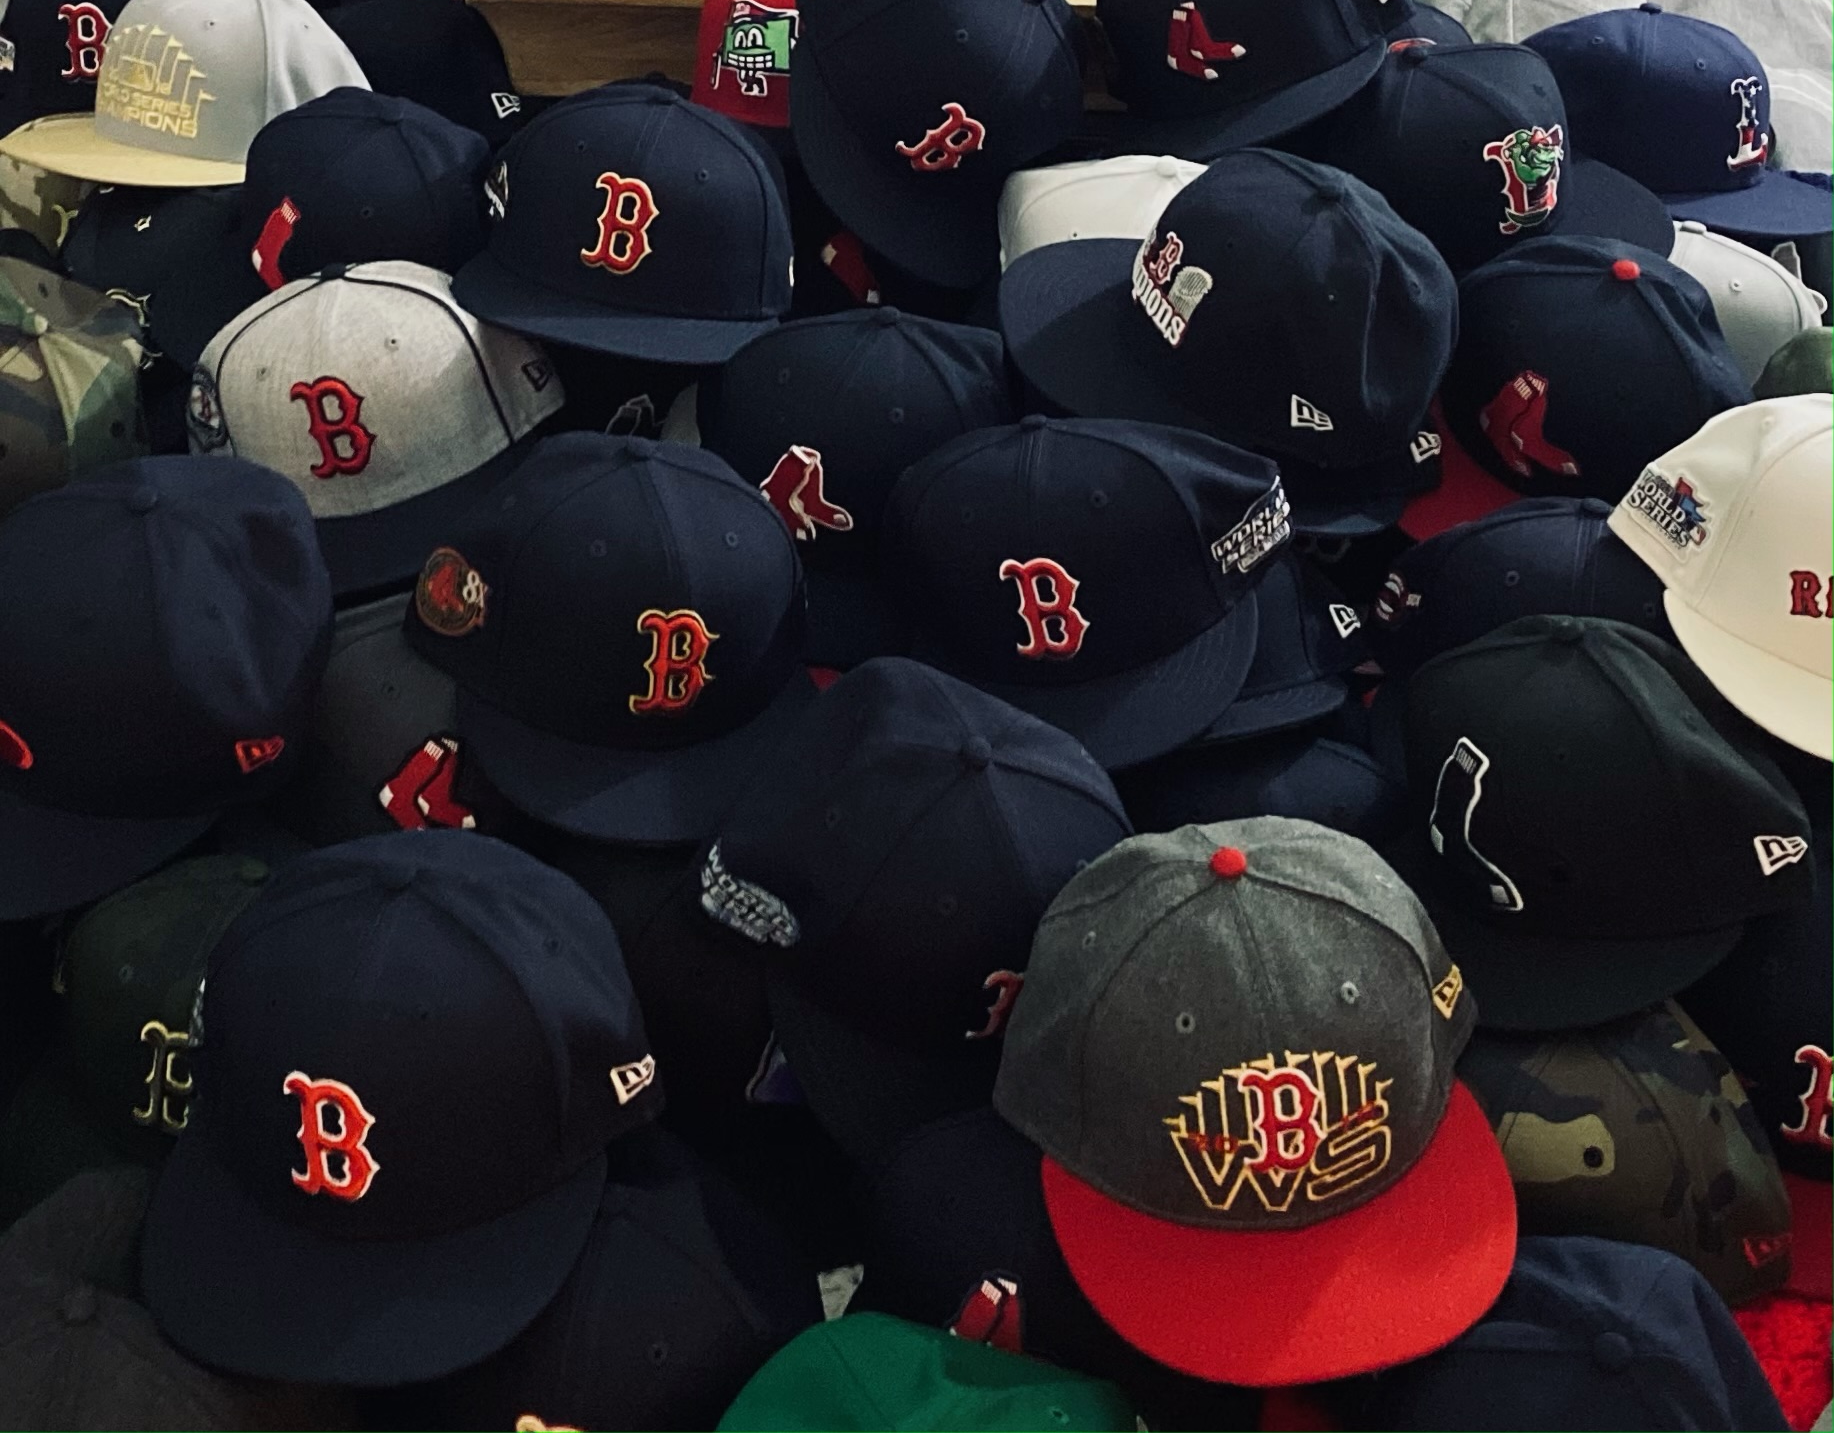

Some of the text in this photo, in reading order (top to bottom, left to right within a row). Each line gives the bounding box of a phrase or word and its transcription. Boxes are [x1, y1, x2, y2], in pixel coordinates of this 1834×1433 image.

[57, 2, 113, 83] B
[131, 91, 193, 119] SERIES
[580, 171, 661, 275] B
[290, 375, 378, 479] B
[1626, 487, 1690, 548] SERIES
[999, 557, 1091, 660] B
[628, 608, 720, 715] B
[283, 1070, 381, 1202] B
[1237, 1066, 1328, 1173] B
